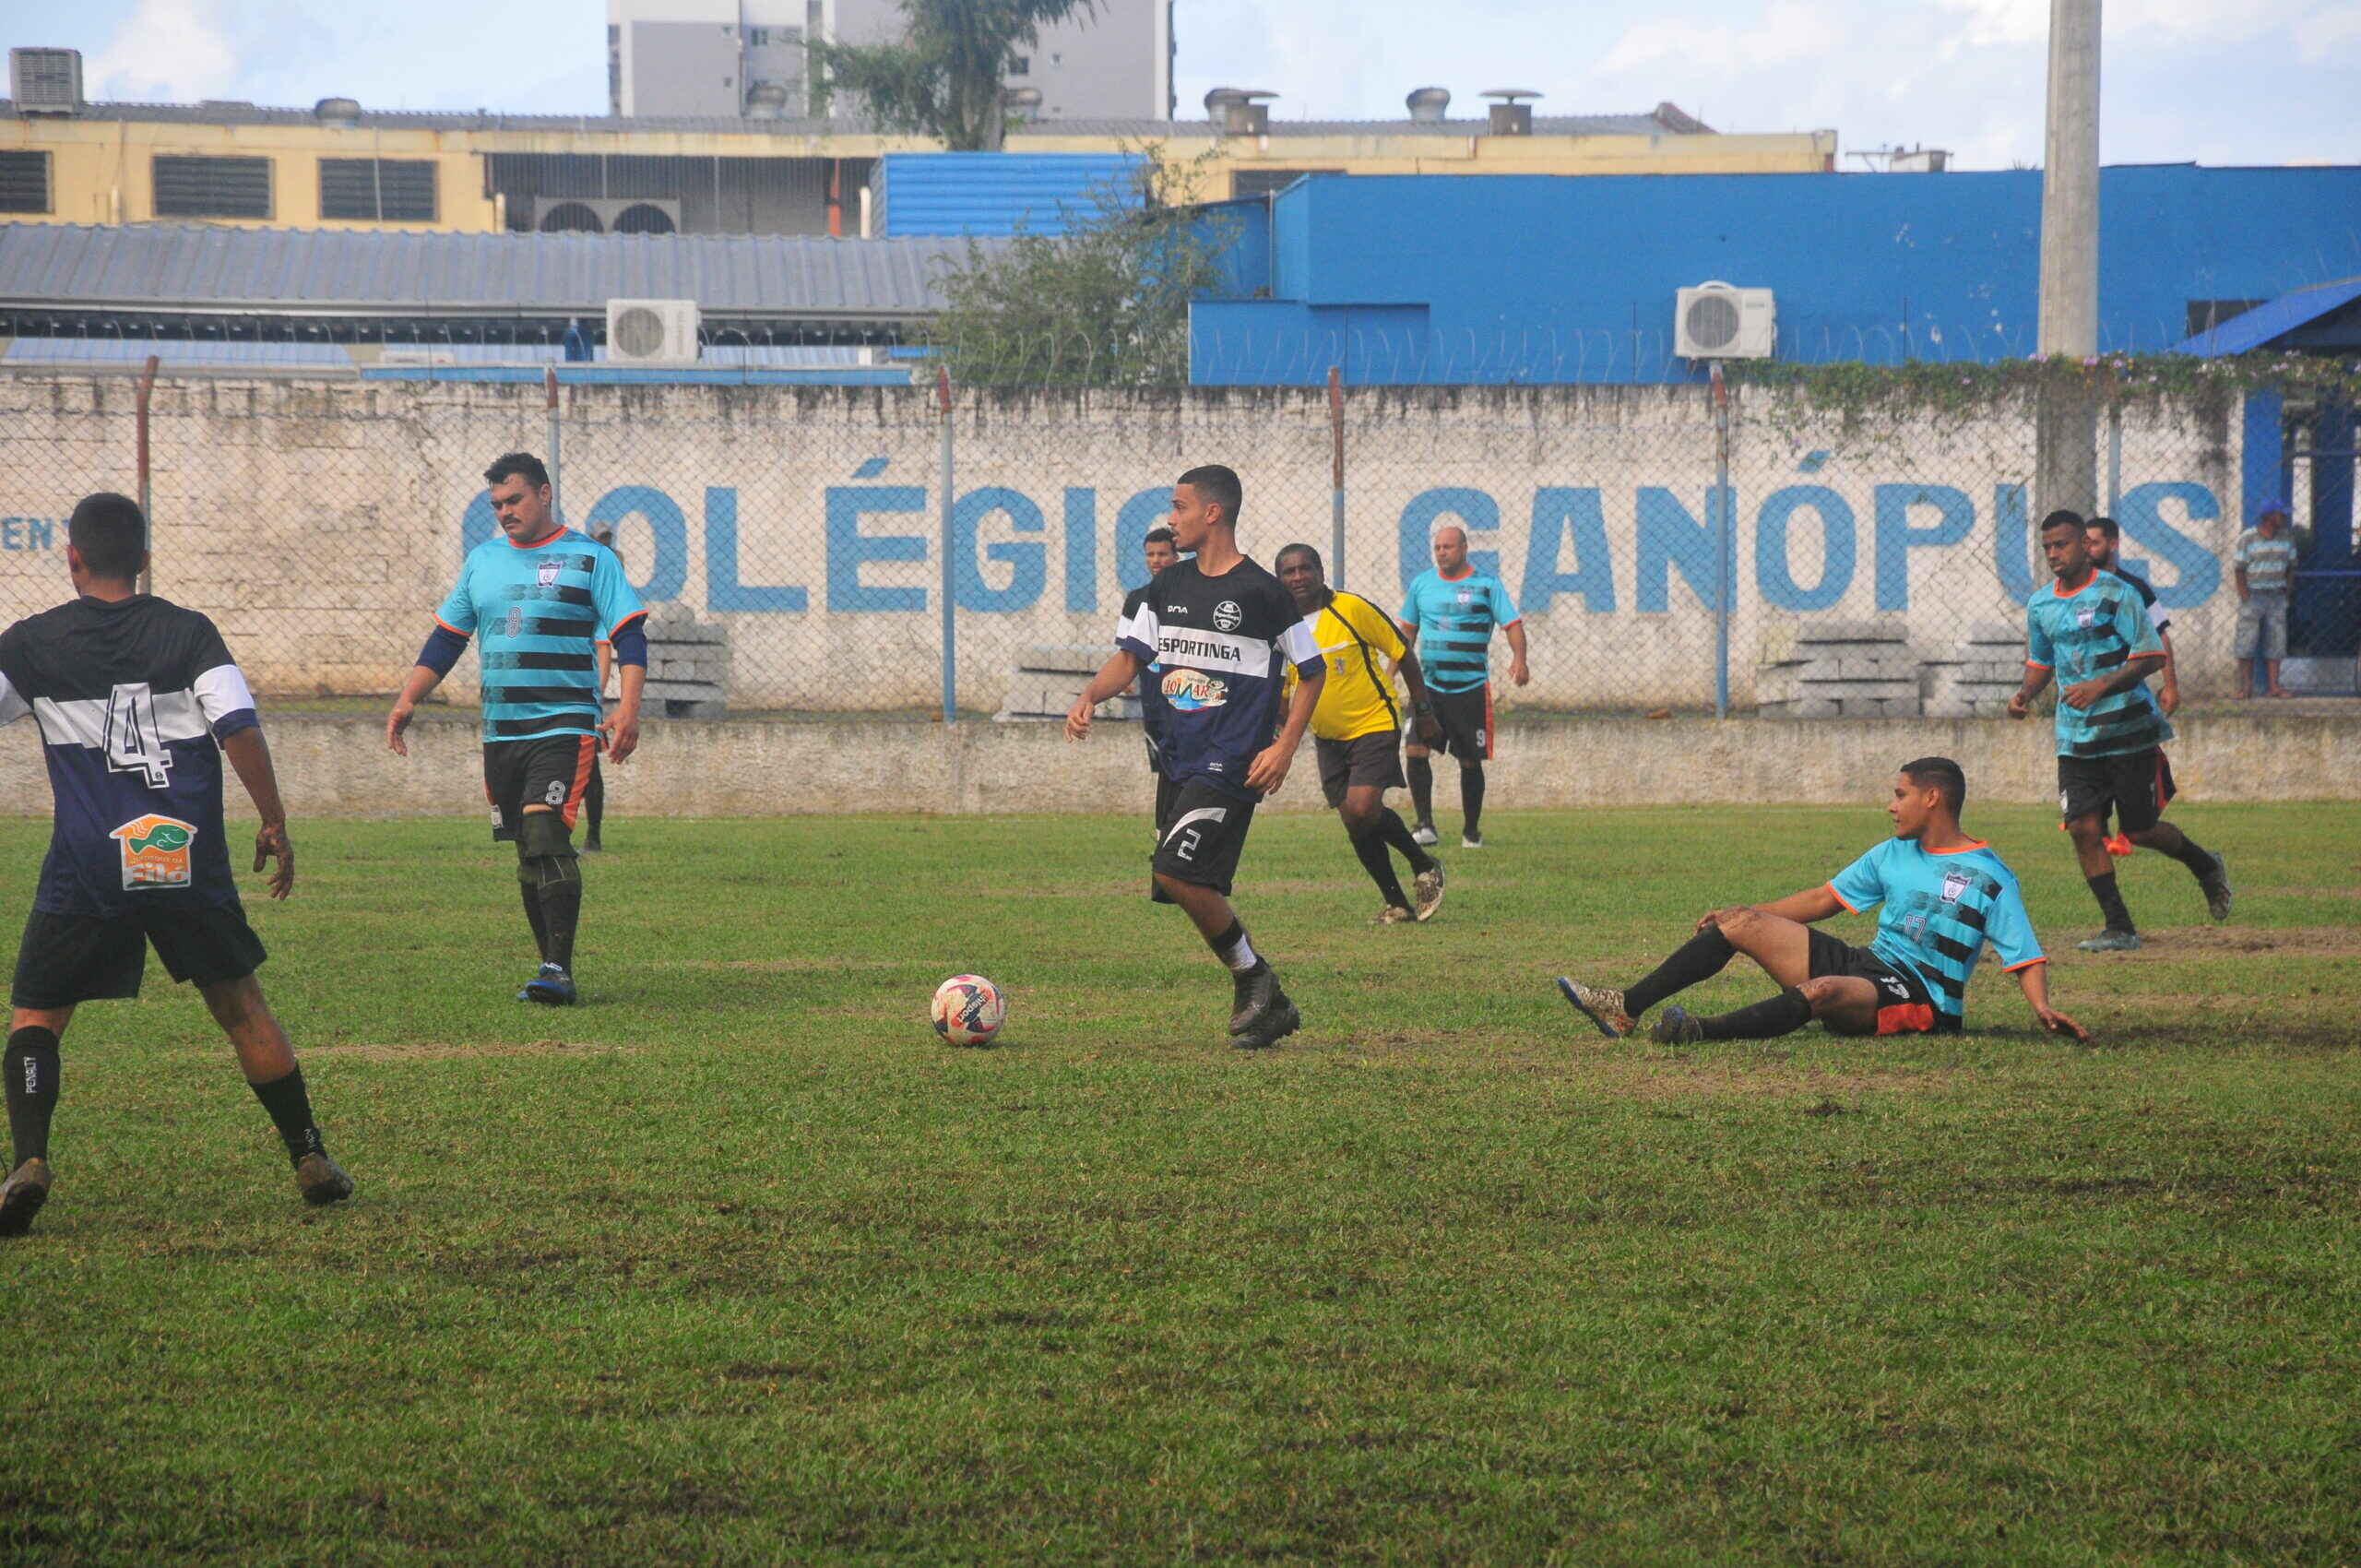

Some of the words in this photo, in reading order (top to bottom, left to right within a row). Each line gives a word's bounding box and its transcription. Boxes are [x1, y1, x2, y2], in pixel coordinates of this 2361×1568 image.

[1158, 636, 1241, 662] ESPORTINGA
[102, 682, 173, 790] 4
[1476, 729, 1487, 748] 9
[545, 779, 566, 805] 8
[1177, 828, 1202, 861] 2
